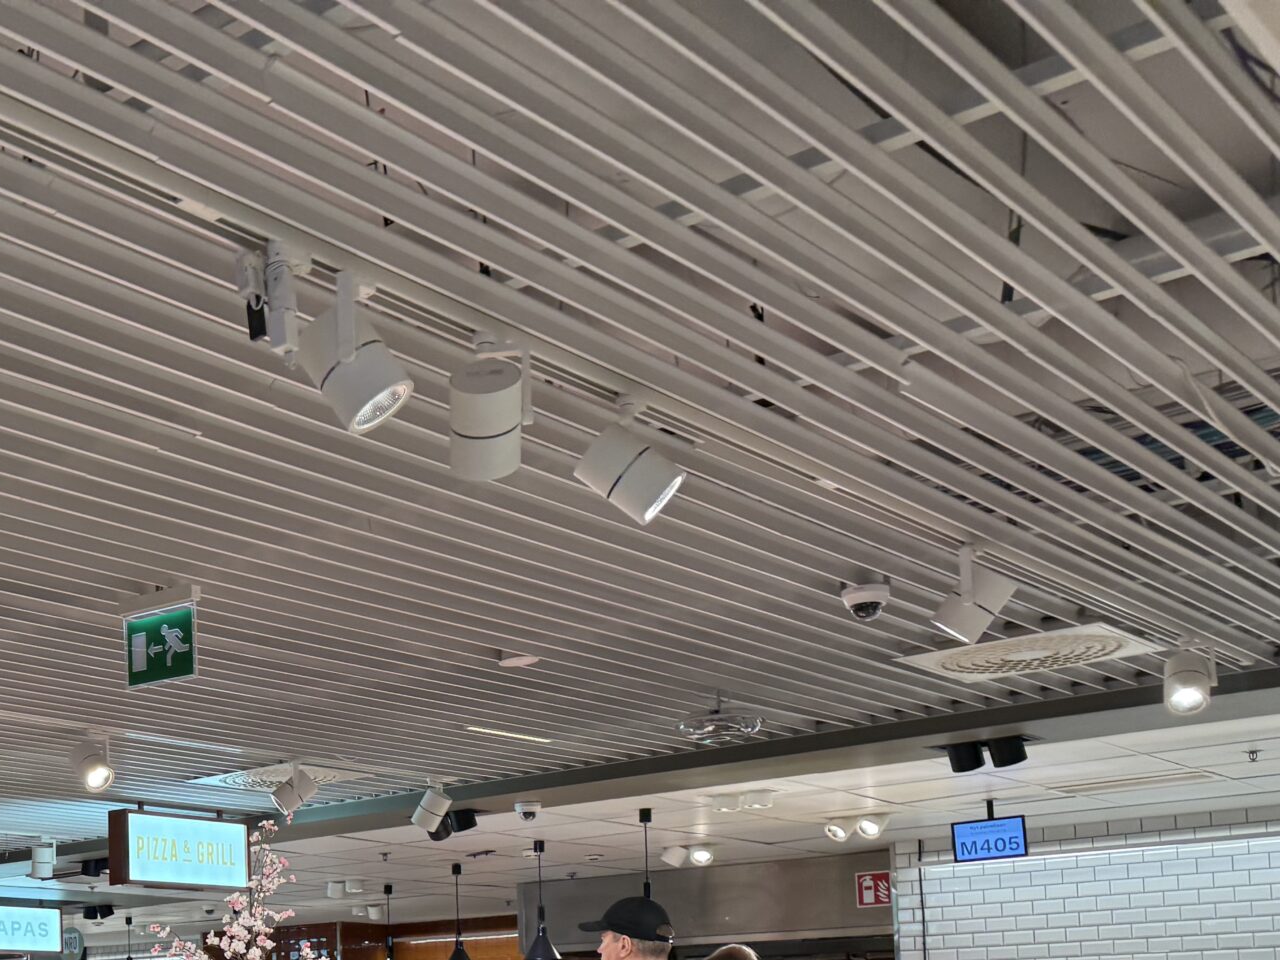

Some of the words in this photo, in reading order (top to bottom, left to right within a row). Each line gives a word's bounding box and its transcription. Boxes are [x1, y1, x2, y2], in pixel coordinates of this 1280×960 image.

[136, 835, 178, 862] PIZZA
[183, 840, 192, 864] &
[197, 841, 236, 866] GRILL
[961, 836, 1020, 856] M405
